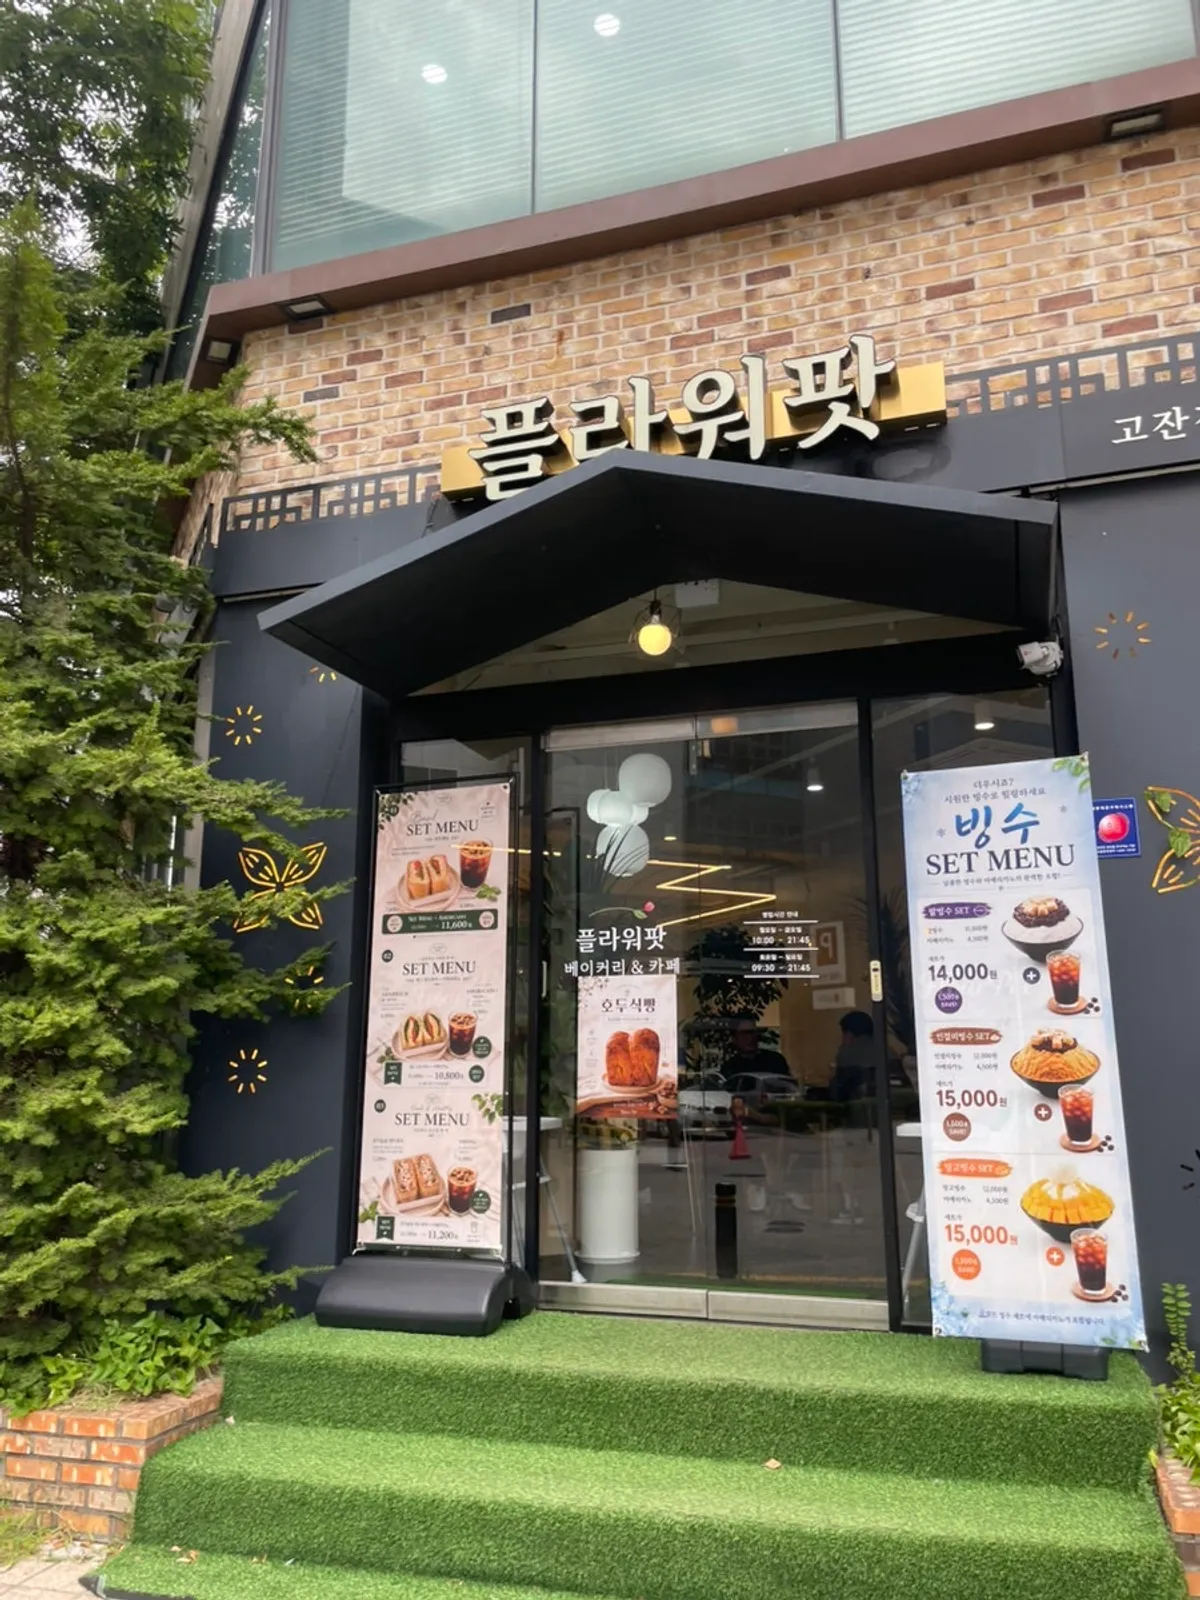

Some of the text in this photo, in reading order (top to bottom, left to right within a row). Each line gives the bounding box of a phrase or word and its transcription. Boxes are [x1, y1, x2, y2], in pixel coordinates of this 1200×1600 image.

[468, 334, 896, 500] 플라워팟
[1111, 406, 1200, 444] 고잔
[406, 819, 479, 836] SET MENU
[955, 802, 1040, 849] 빙수
[926, 844, 1075, 876] SET MENU
[954, 906, 970, 915] SET
[576, 925, 667, 953] 플라워팟
[752, 936, 775, 944] 10:00
[787, 936, 810, 944] 21:45
[402, 961, 477, 976] SET MENU
[564, 957, 680, 977] 베이커리 & 카페
[751, 964, 775, 972] 09:30
[788, 964, 811, 972] 21:45
[928, 963, 998, 983] 14,000원
[975, 1031, 990, 1040] SET
[936, 1089, 1007, 1110] 15,000원
[394, 1113, 470, 1126] SET MENU
[944, 1224, 1018, 1246] 15,000원
